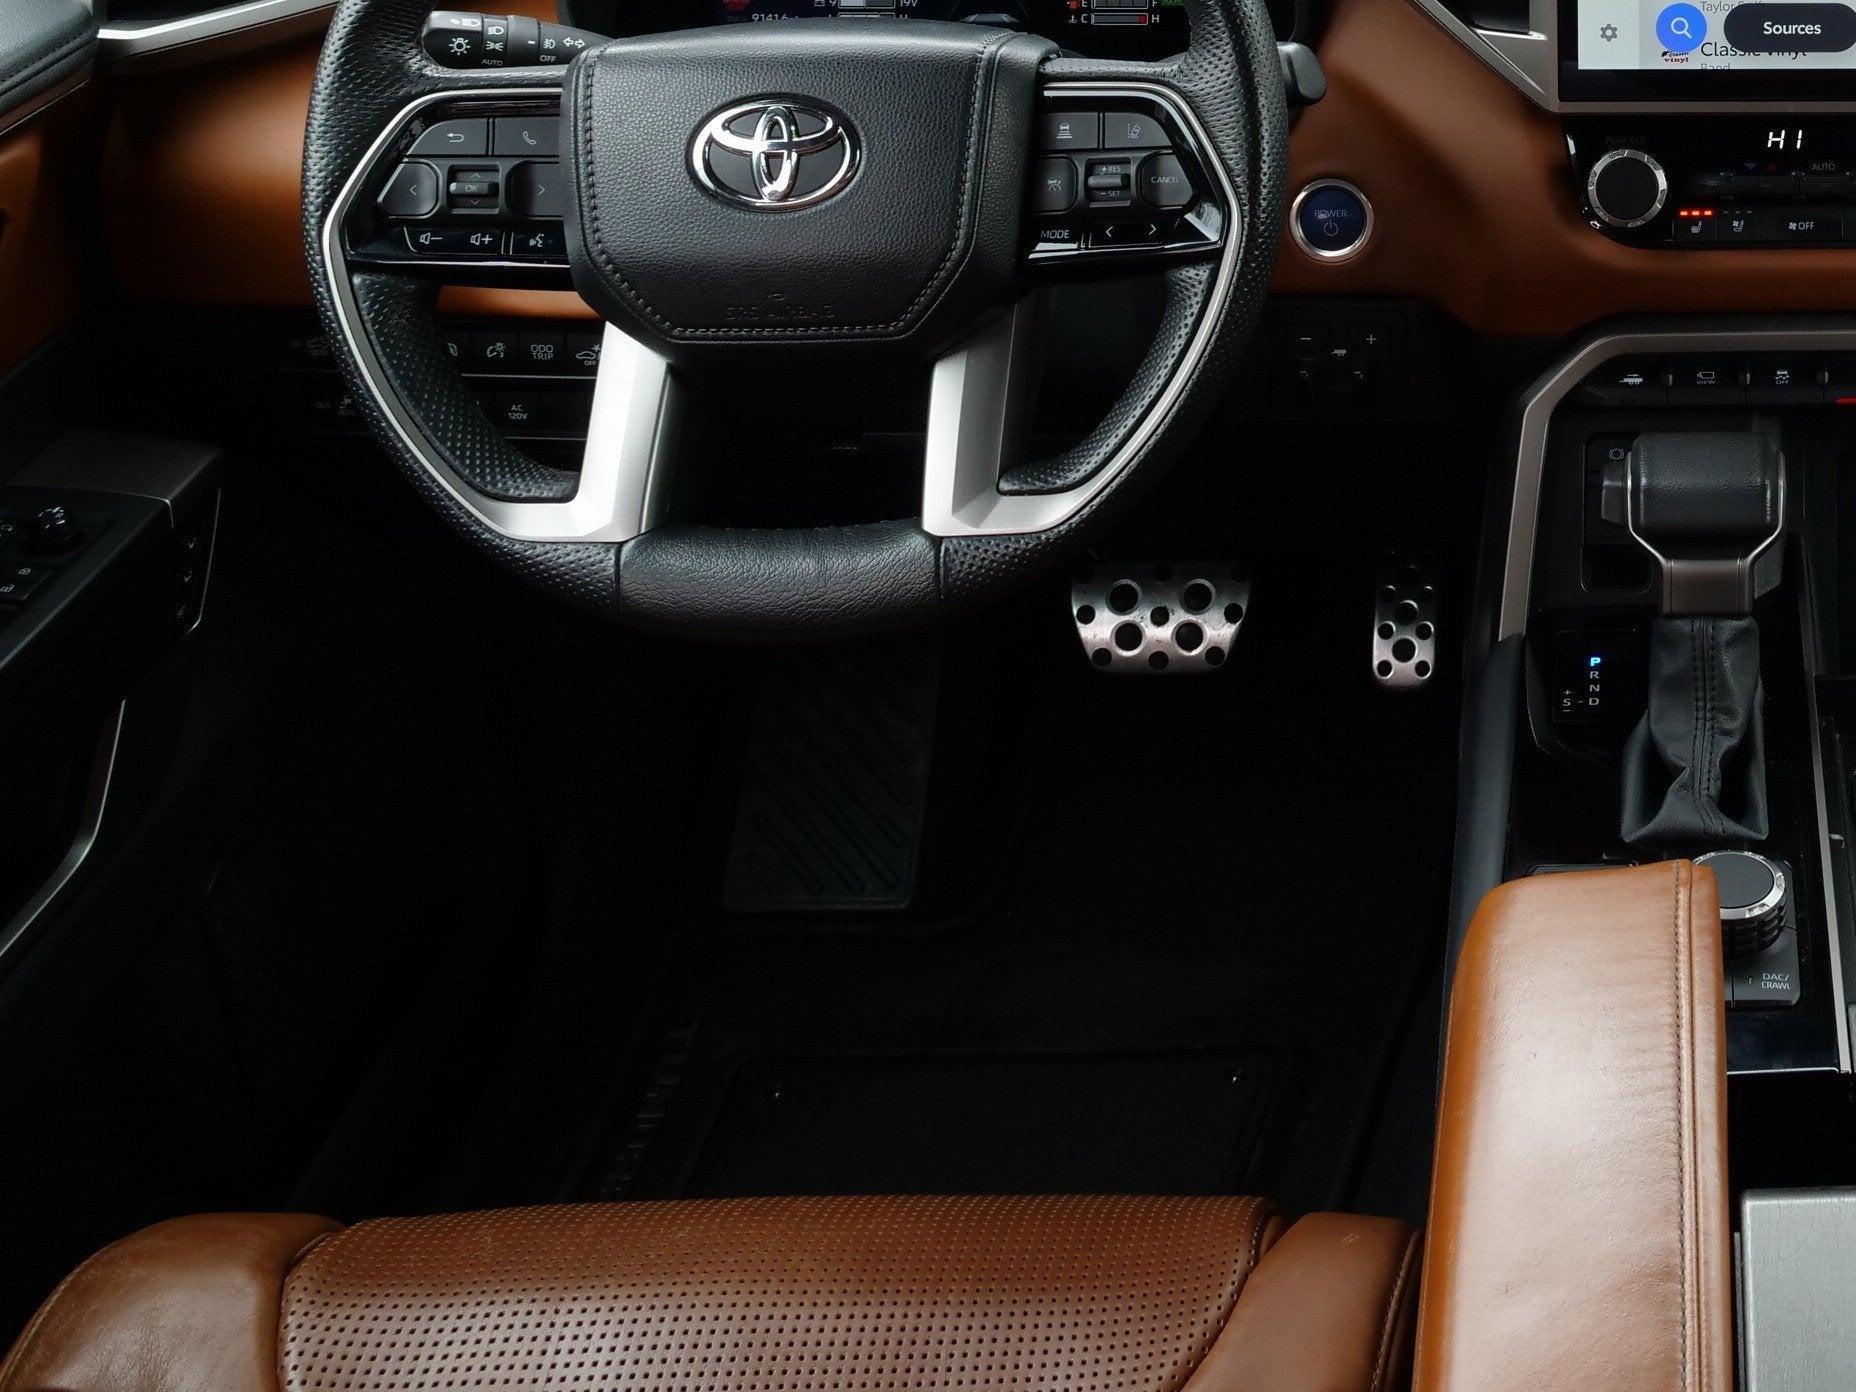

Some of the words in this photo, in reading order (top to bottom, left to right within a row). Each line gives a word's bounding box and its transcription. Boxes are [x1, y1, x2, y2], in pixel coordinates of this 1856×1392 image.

[1701, 1, 1733, 14] Taylor
[1081, 14, 1088, 23] C
[1152, 14, 1160, 23] H
[1763, 22, 1822, 35] Sources
[481, 58, 503, 67] AUTO
[540, 55, 556, 63] OFF
[1767, 129, 1804, 150] HI
[1812, 162, 1836, 172] AUTO
[1150, 176, 1180, 185] CANCEL
[465, 184, 478, 192] OK
[1314, 209, 1347, 218] POWER
[1798, 222, 1816, 230] OFF
[1040, 230, 1070, 240] MODE
[530, 344, 554, 352] ODO
[532, 352, 554, 360] TRIP
[510, 404, 523, 412] AC
[508, 412, 528, 420] 120V
[1590, 656, 1601, 666] P
[1589, 670, 1600, 679] R
[1589, 684, 1600, 692] N
[1562, 698, 1571, 706] S
[1588, 698, 1600, 706] D
[1762, 972, 1789, 981] DAC/
[1761, 981, 1792, 990] CRAWL
